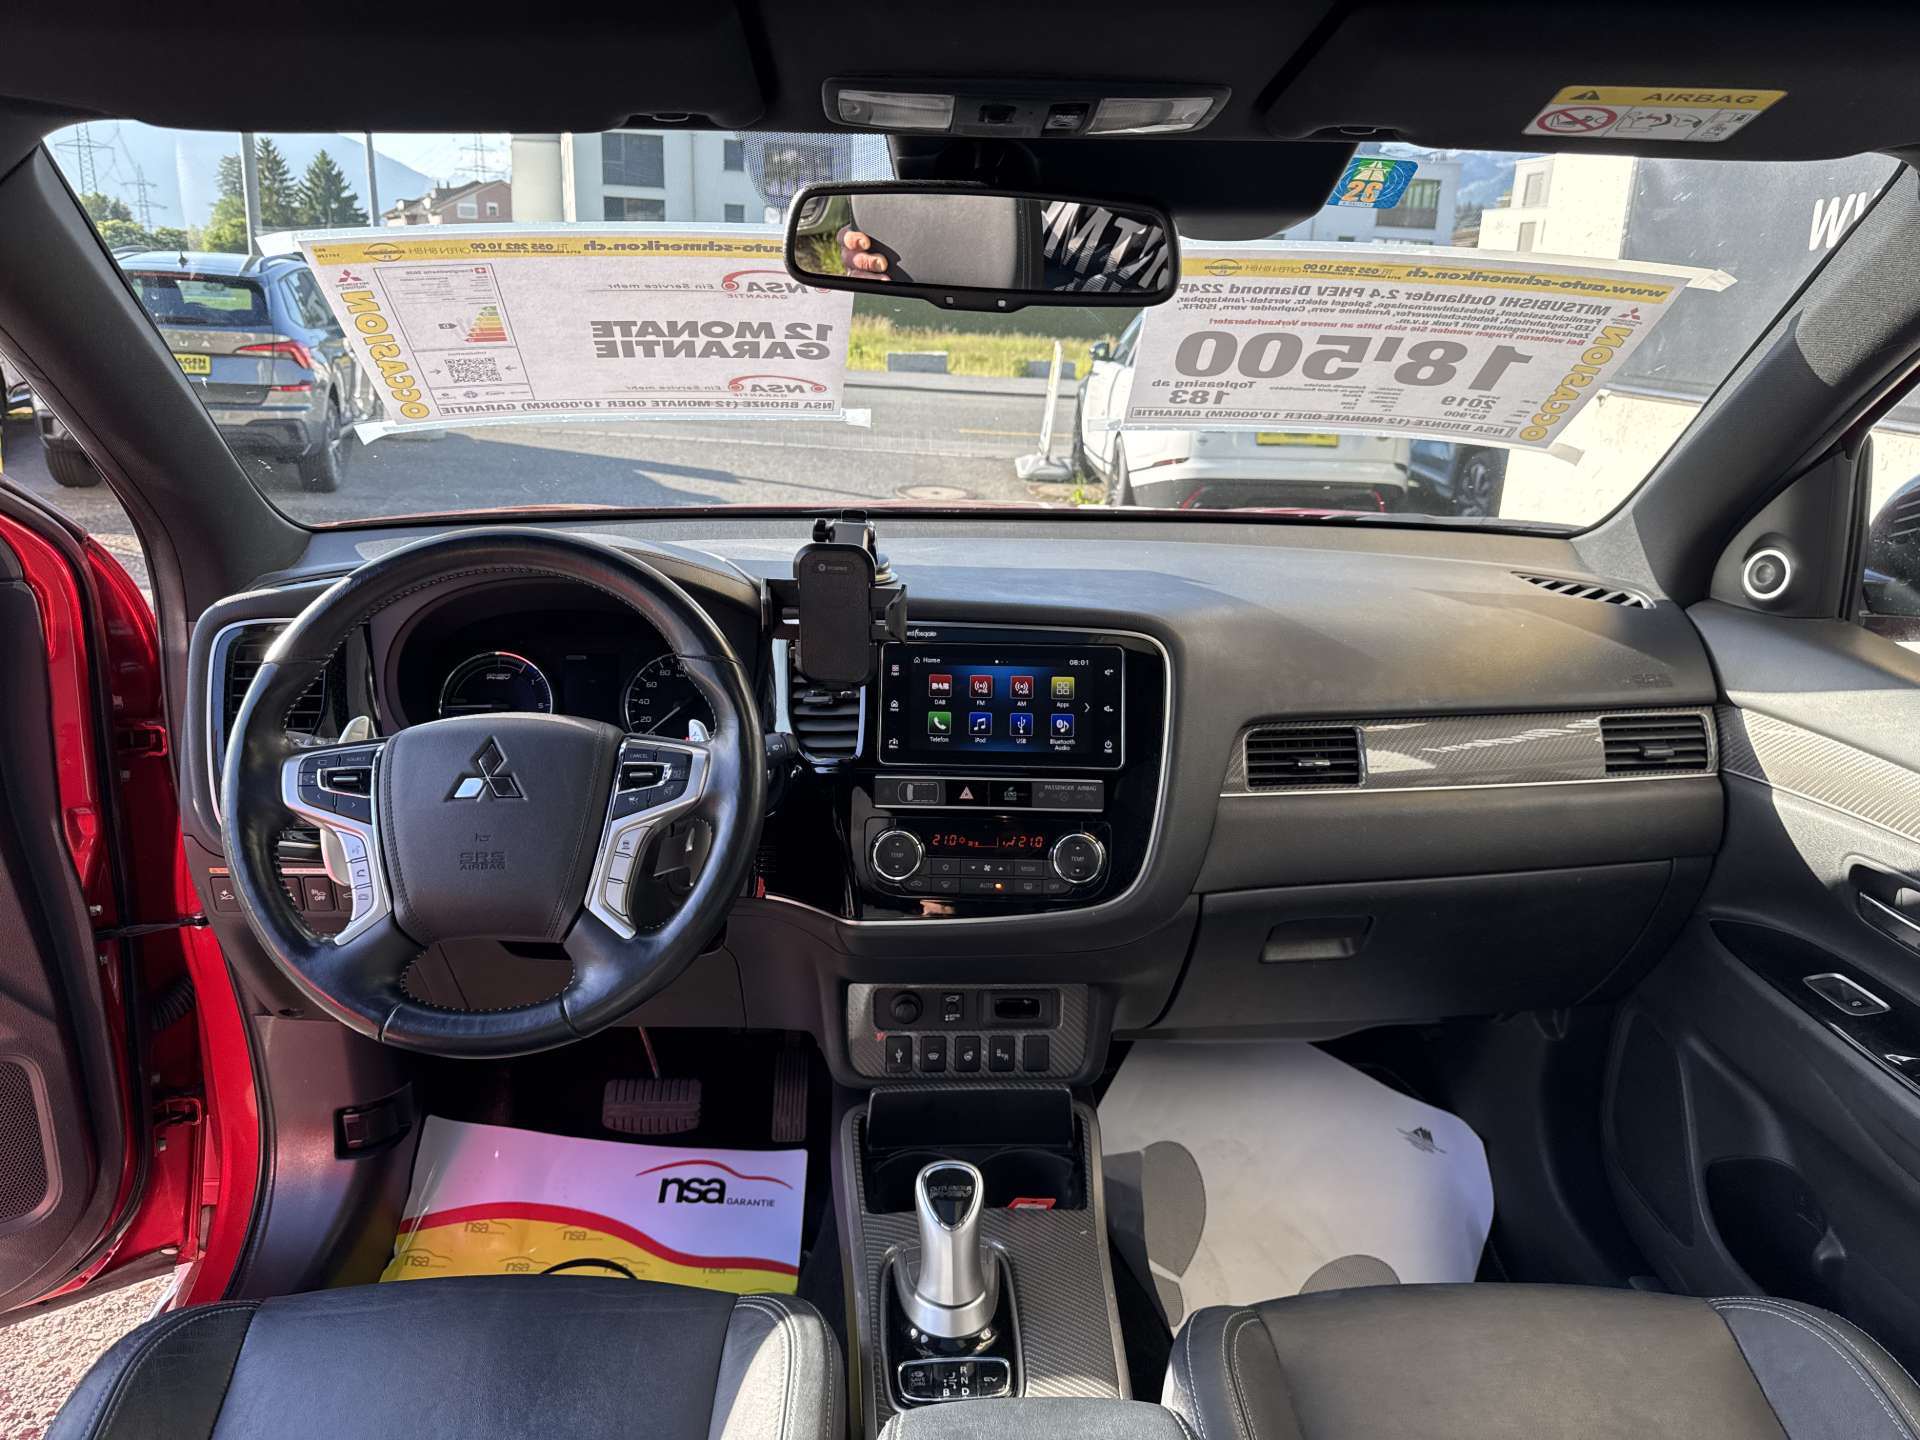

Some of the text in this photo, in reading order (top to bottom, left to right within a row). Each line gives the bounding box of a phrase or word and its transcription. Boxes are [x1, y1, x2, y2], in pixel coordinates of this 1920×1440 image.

[1641, 92, 1758, 104] AIRBAG
[1341, 180, 1383, 203] 26
[1808, 188, 1882, 251] W
[923, 656, 941, 664] Home
[931, 682, 950, 690] DAB
[1056, 701, 1070, 709] Apps
[640, 715, 652, 723] 20
[1050, 738, 1076, 746] Bluetooth
[658, 1177, 776, 1207] nsa GARANTIE
[464, 1220, 489, 1233] nsa
[562, 1229, 586, 1240] nsa
[404, 1253, 430, 1267] nsa
[505, 1261, 529, 1272] nsa
[960, 1366, 967, 1374] R
[961, 1376, 969, 1385] N
[942, 1387, 950, 1396] B
[961, 1387, 970, 1396] D
